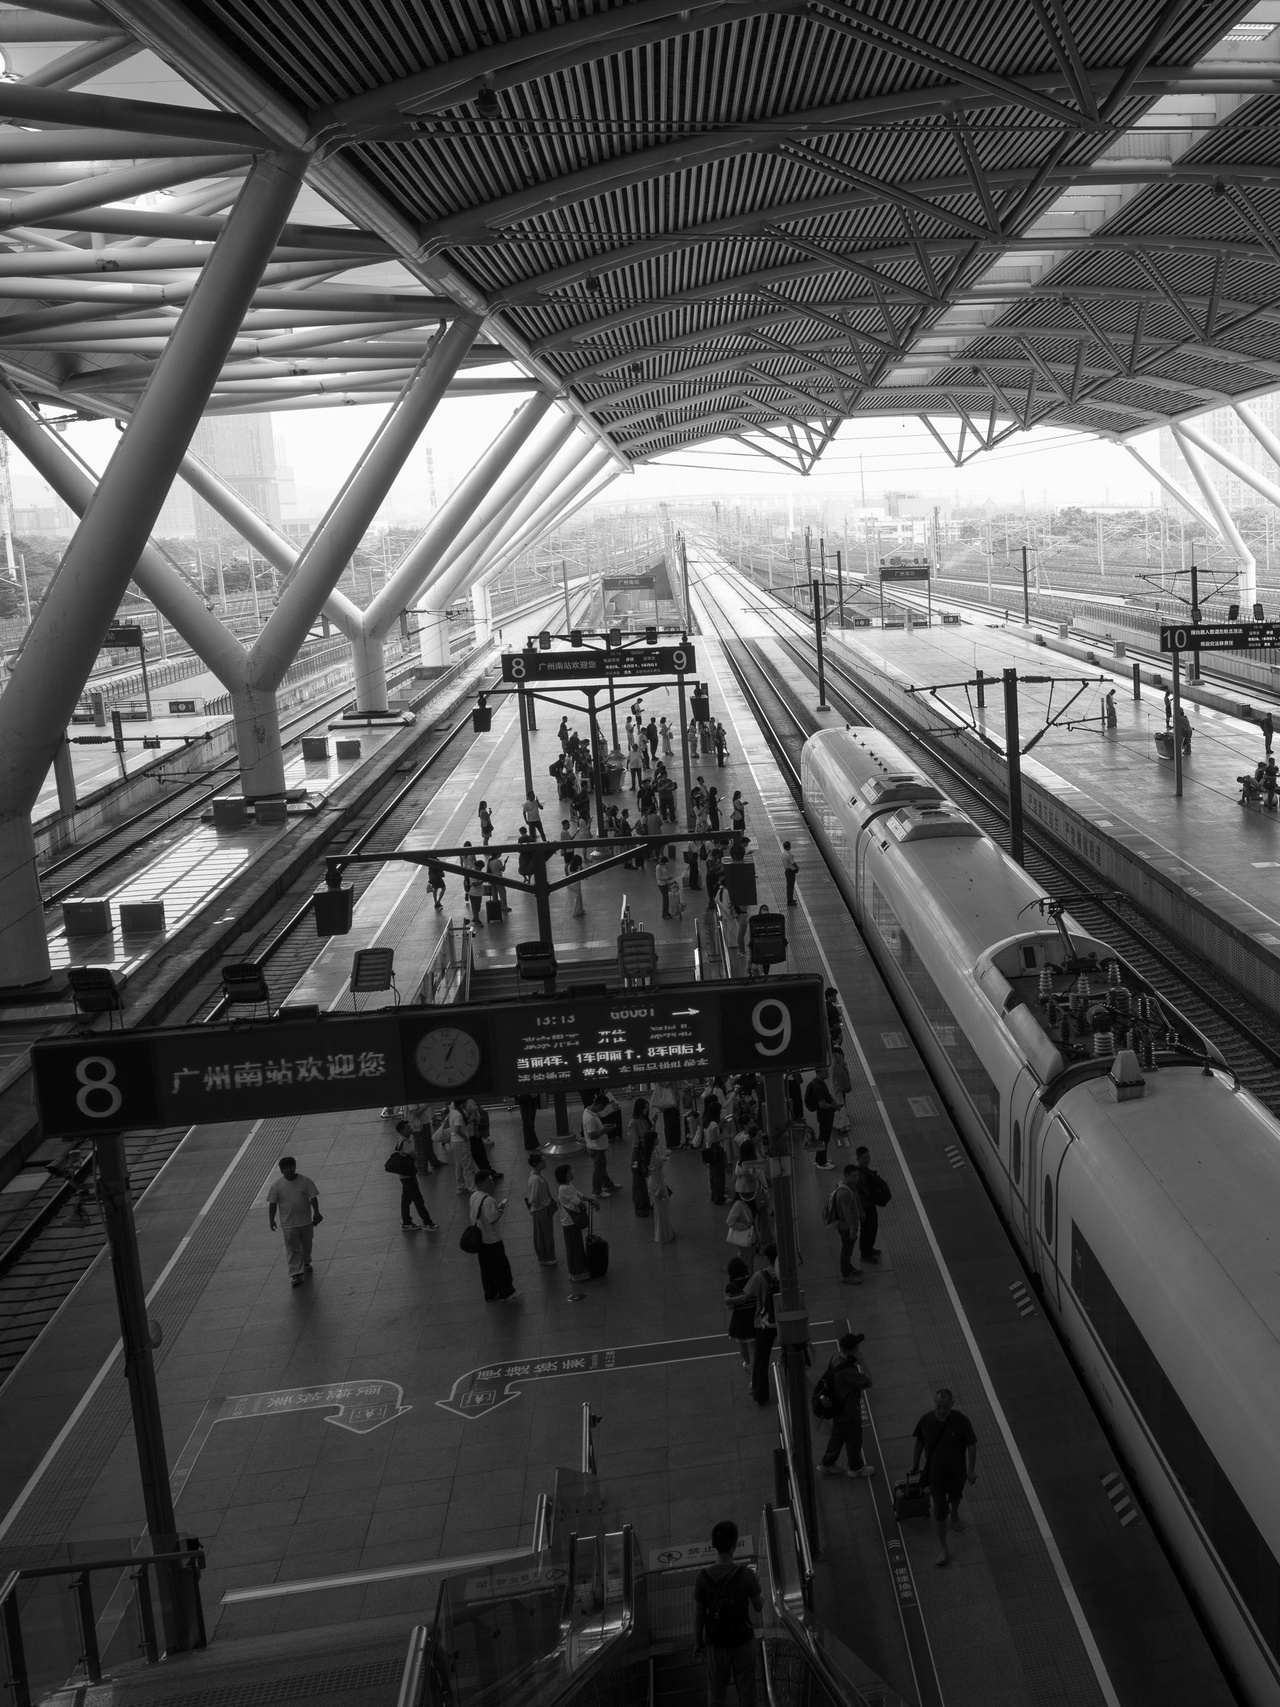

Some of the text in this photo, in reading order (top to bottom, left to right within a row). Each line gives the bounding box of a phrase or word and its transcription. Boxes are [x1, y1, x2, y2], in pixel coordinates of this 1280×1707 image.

[1163, 628, 1187, 649] 10
[511, 658, 526, 679] 8
[538, 661, 597, 671] 广州南站欢迎您
[672, 650, 687, 670] 9
[751, 998, 792, 1057] 9
[171, 1051, 386, 1095] 广州南站欢迎您
[75, 1055, 123, 1119] 8
[476, 1357, 587, 1380] 便捷换乘
